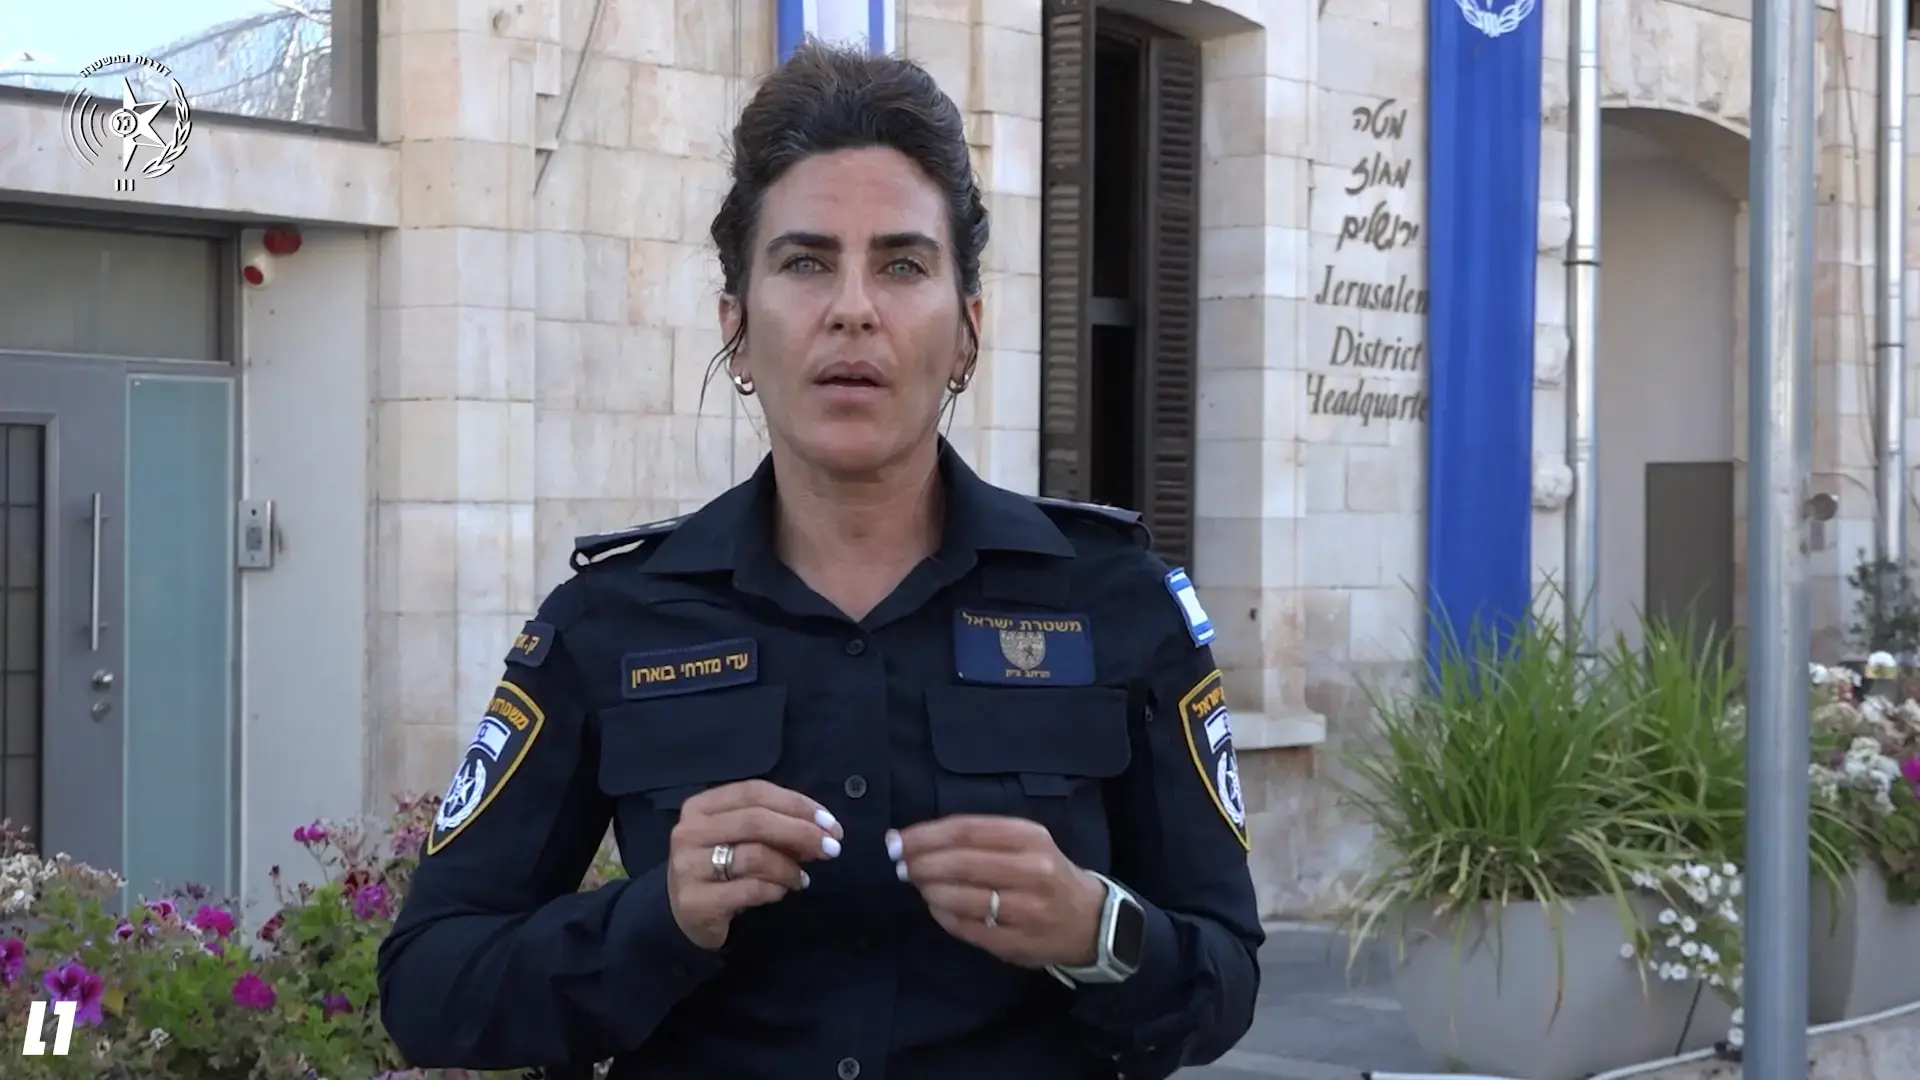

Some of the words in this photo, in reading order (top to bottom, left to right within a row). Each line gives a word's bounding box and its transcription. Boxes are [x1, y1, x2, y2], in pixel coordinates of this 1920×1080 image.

[1352, 98, 1407, 139] מטה
[1345, 151, 1411, 195] מחוז
[1336, 200, 1419, 251] ירושלים
[1329, 325, 1423, 371] District
[1307, 373, 1430, 427] Headquarte
[962, 611, 1014, 629] ישראל
[1020, 619, 1083, 632] משטרת
[631, 665, 677, 689] בוארון
[680, 657, 722, 678] מזרחי
[725, 653, 749, 670] עדי
